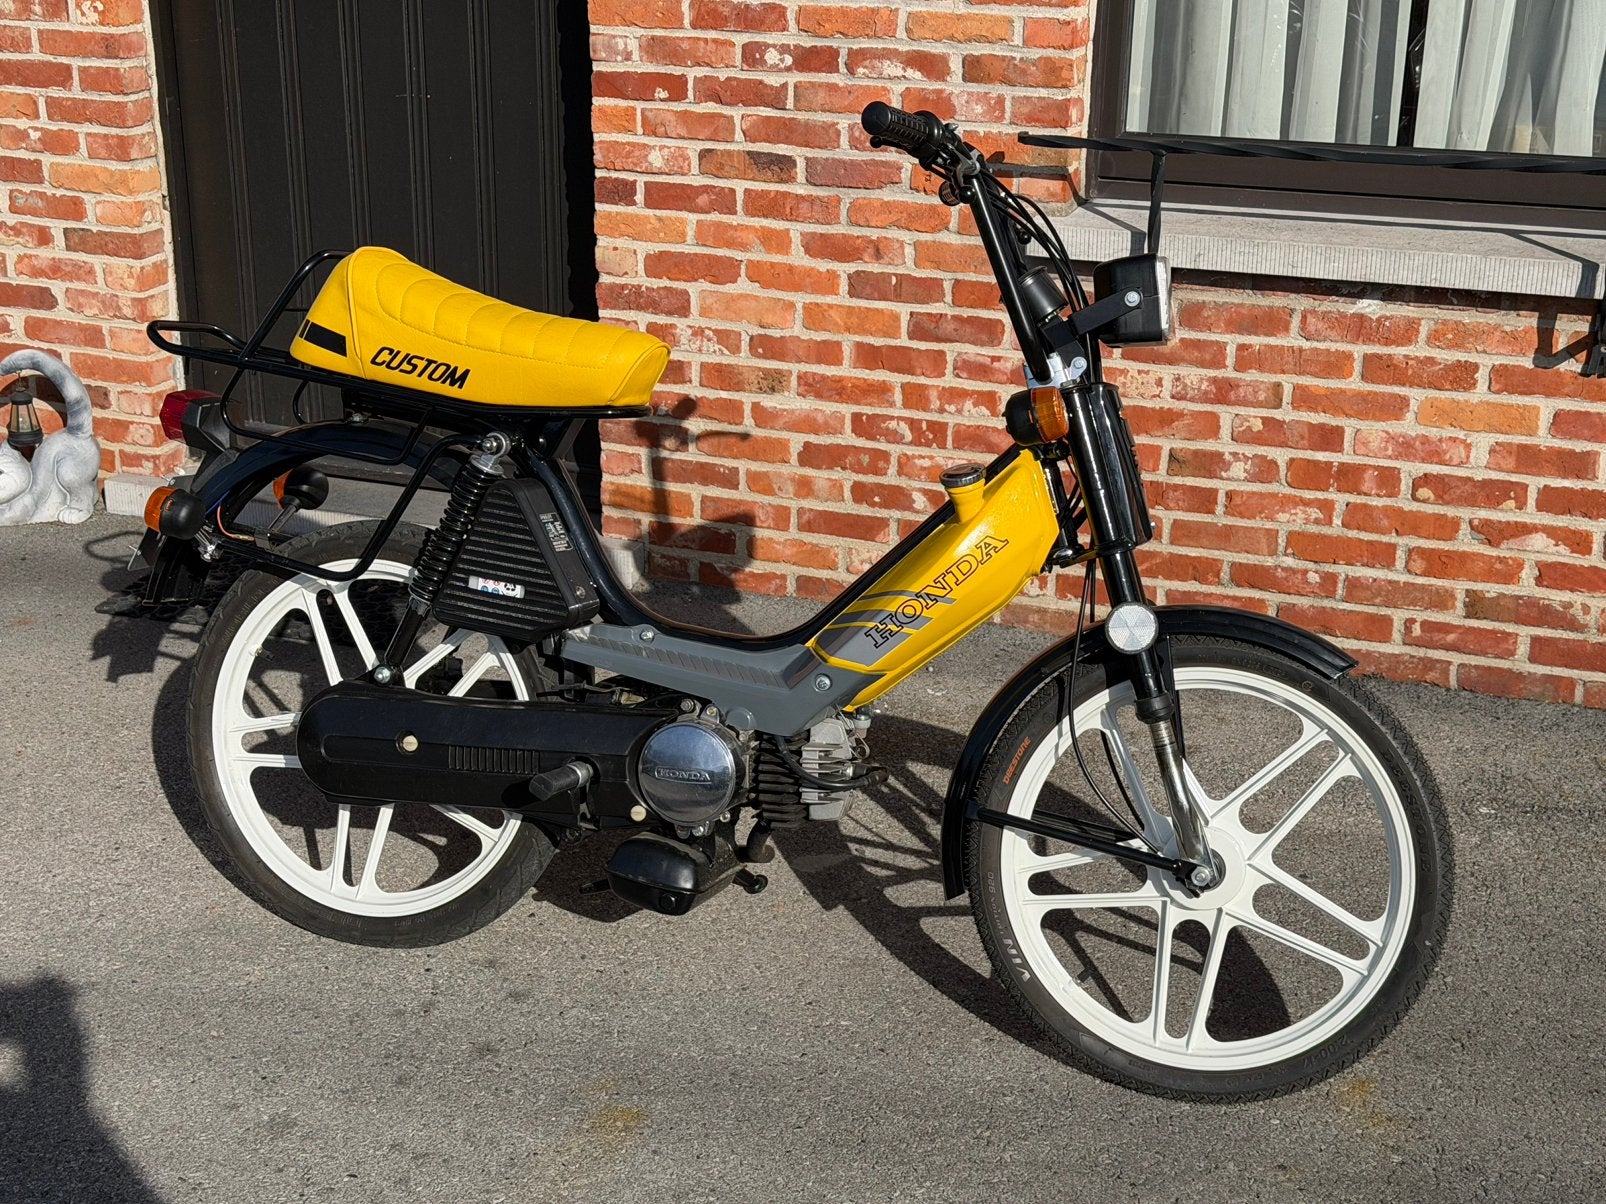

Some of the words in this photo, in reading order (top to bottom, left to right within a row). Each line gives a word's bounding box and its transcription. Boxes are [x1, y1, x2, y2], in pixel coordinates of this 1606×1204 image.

[370, 346, 471, 389] CUSTOM
[864, 535, 1010, 648] HONDA
[658, 767, 711, 781] HONDA
[1003, 736, 1032, 785] DEESTONE
